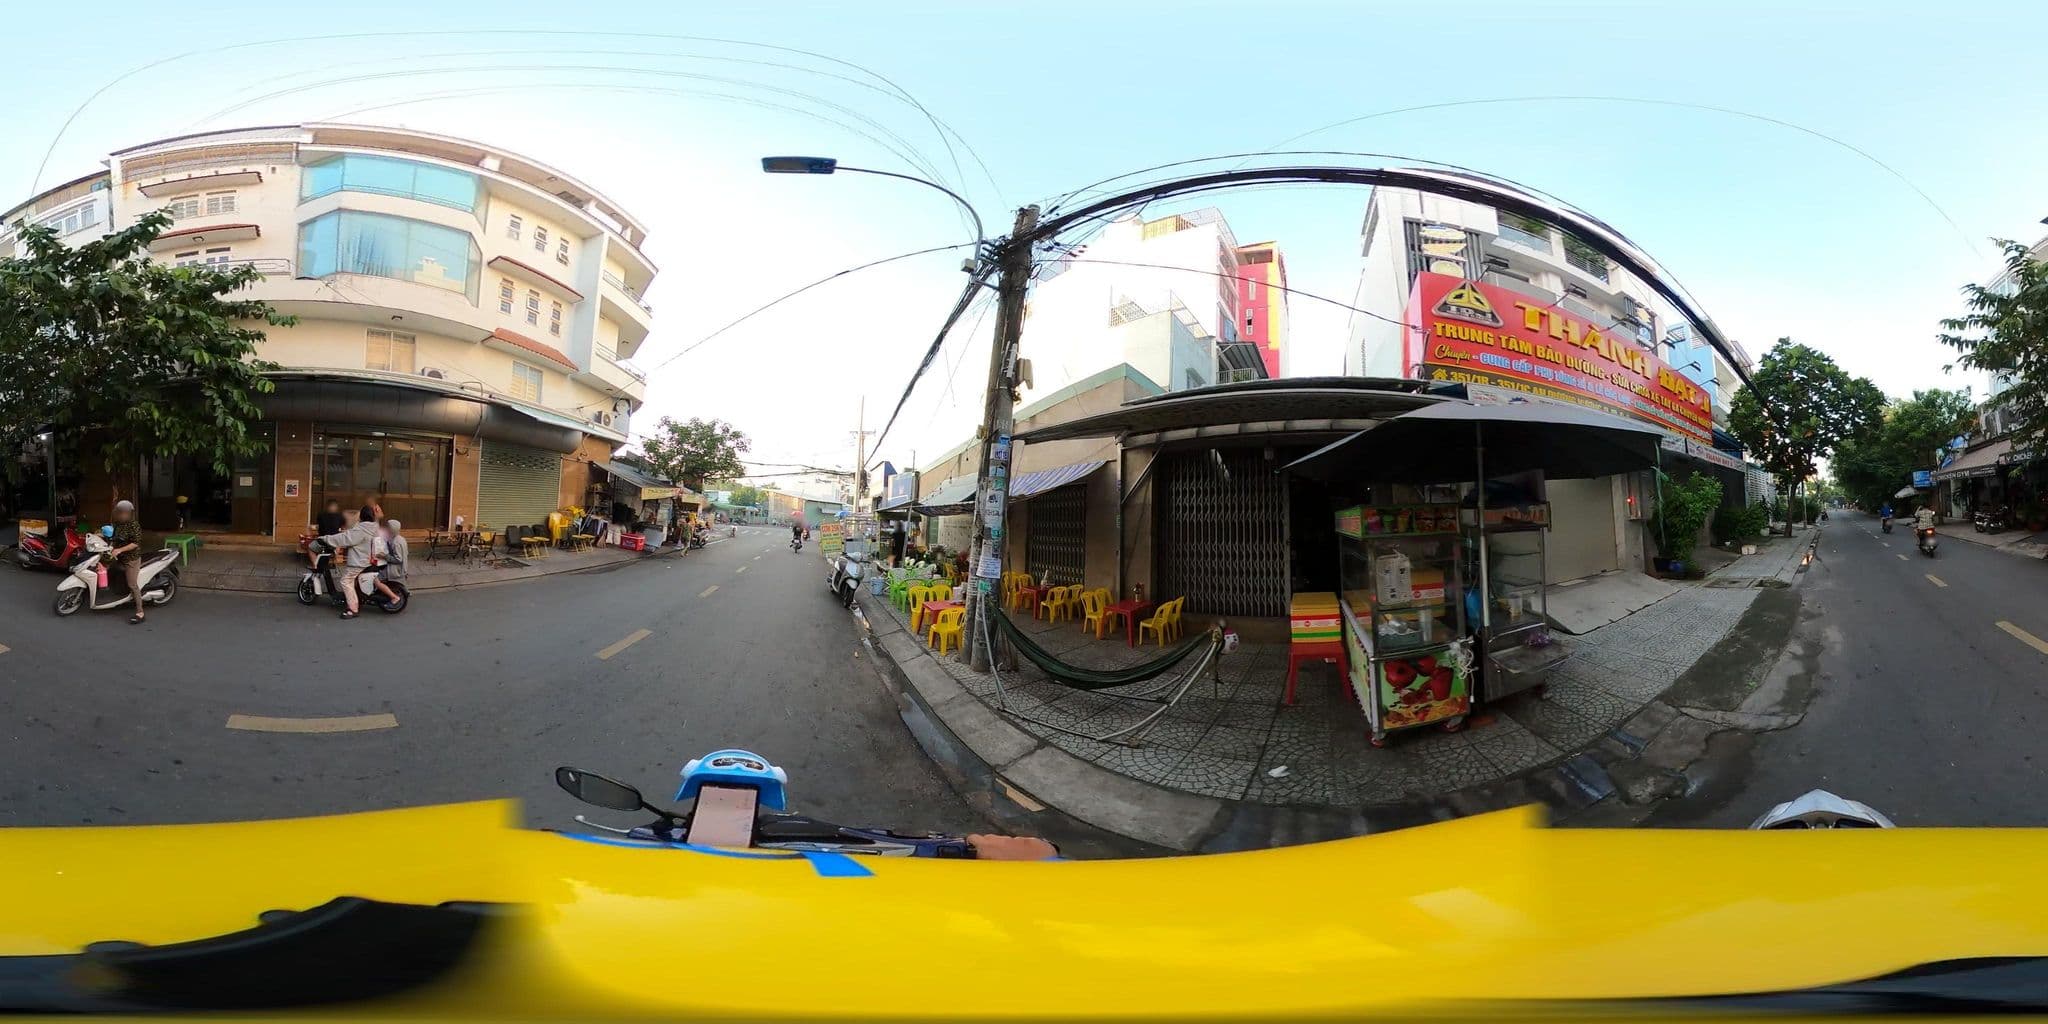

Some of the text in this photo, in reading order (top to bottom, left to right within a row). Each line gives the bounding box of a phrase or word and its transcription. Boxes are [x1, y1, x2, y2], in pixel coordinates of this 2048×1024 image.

[1434, 322, 1495, 346] TRUNG
[1499, 335, 1532, 356] TÂM
[1514, 301, 1653, 379] THÀNH
[1658, 366, 1697, 405] ĐẠT
[1434, 344, 1471, 364] Chuyên
[1480, 352, 1511, 369] CUNG
[1512, 359, 1533, 374] CẤP
[1956, 470, 1970, 478] GYM
